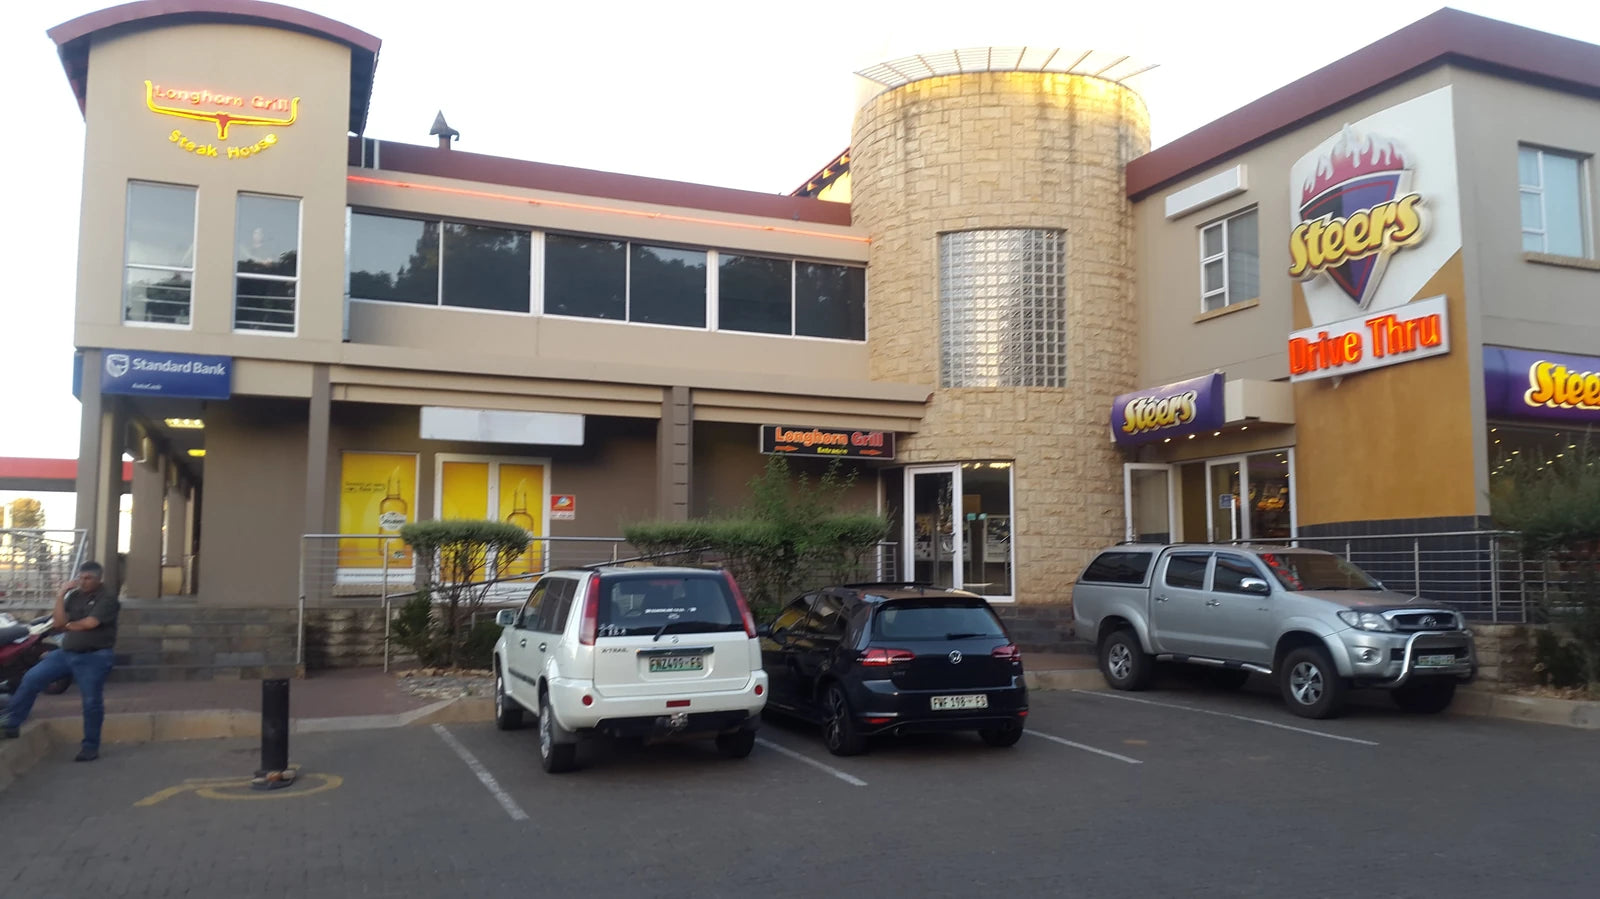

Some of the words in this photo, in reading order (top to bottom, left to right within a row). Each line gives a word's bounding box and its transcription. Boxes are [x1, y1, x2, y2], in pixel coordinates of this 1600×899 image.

[153, 85, 243, 107] Longhorn
[251, 95, 289, 112] Grill
[168, 129, 218, 157] Steak
[227, 133, 279, 159] House
[1288, 192, 1422, 278] Steers
[1288, 331, 1363, 375] Drive
[1365, 314, 1443, 358] Thru
[132, 358, 192, 373] Standard
[192, 362, 226, 376] Bank
[1121, 390, 1197, 434] Steers
[775, 426, 848, 447] Longhorn
[851, 431, 884, 446] Grill
[816, 446, 848, 455] Entrance
